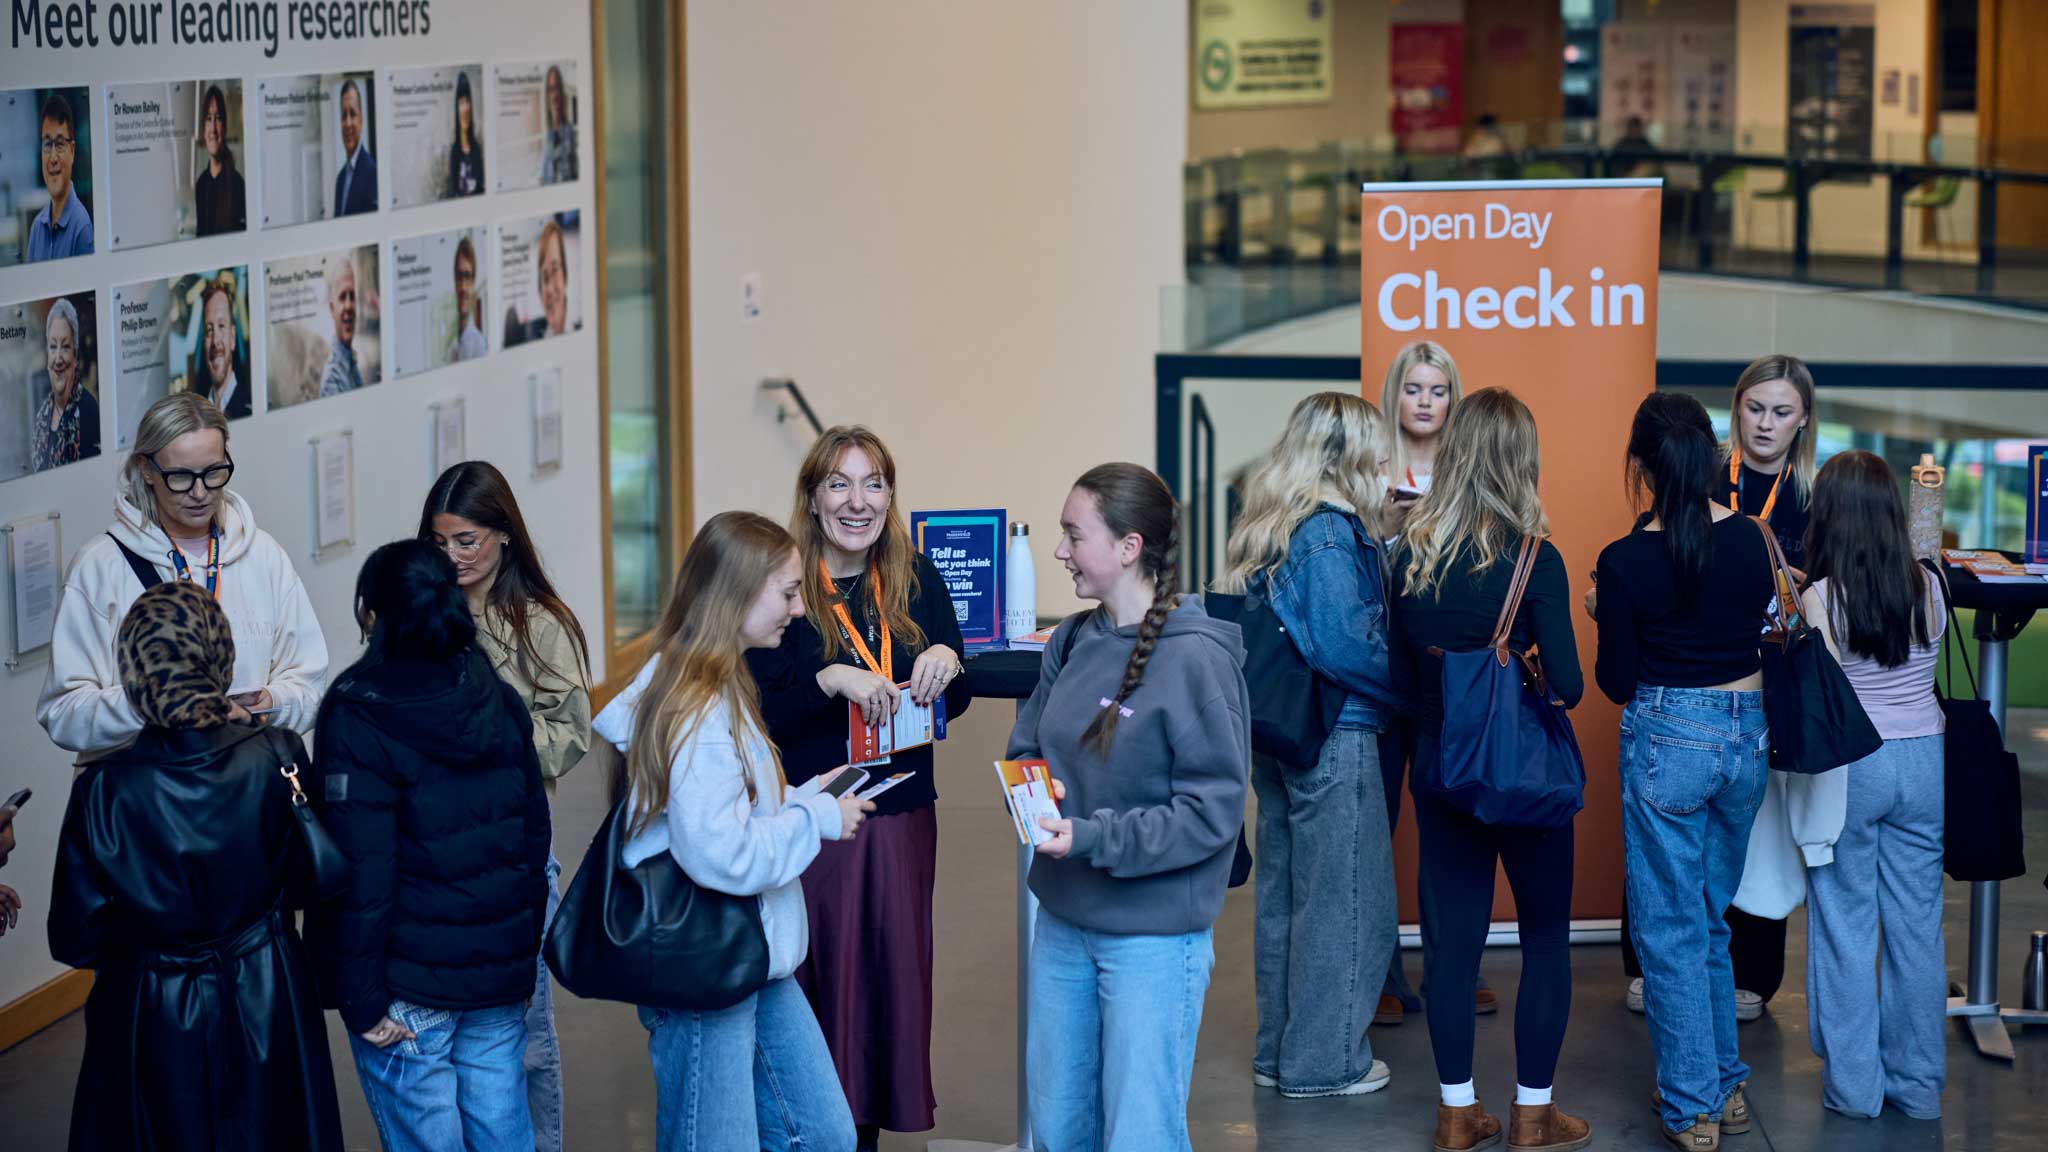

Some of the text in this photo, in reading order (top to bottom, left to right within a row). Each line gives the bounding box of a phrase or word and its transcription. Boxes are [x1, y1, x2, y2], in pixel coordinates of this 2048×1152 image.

[12, 0, 431, 58] Meet our leading researchers
[114, 101, 160, 116] Dr Rowan Bailey
[1377, 203, 1552, 251] Open Day
[1378, 267, 1644, 331] Check in
[121, 301, 149, 315] Professor
[121, 317, 157, 333] Philip Brown
[0, 326, 27, 340] Bettany
[931, 547, 967, 559] Tell us
[934, 558, 991, 571] hat you think
[960, 569, 973, 577] Day
[952, 578, 973, 591] win
[840, 624, 849, 640] STA
[850, 647, 861, 664] STAFF
[1695, 1136, 1711, 1145] UGG
